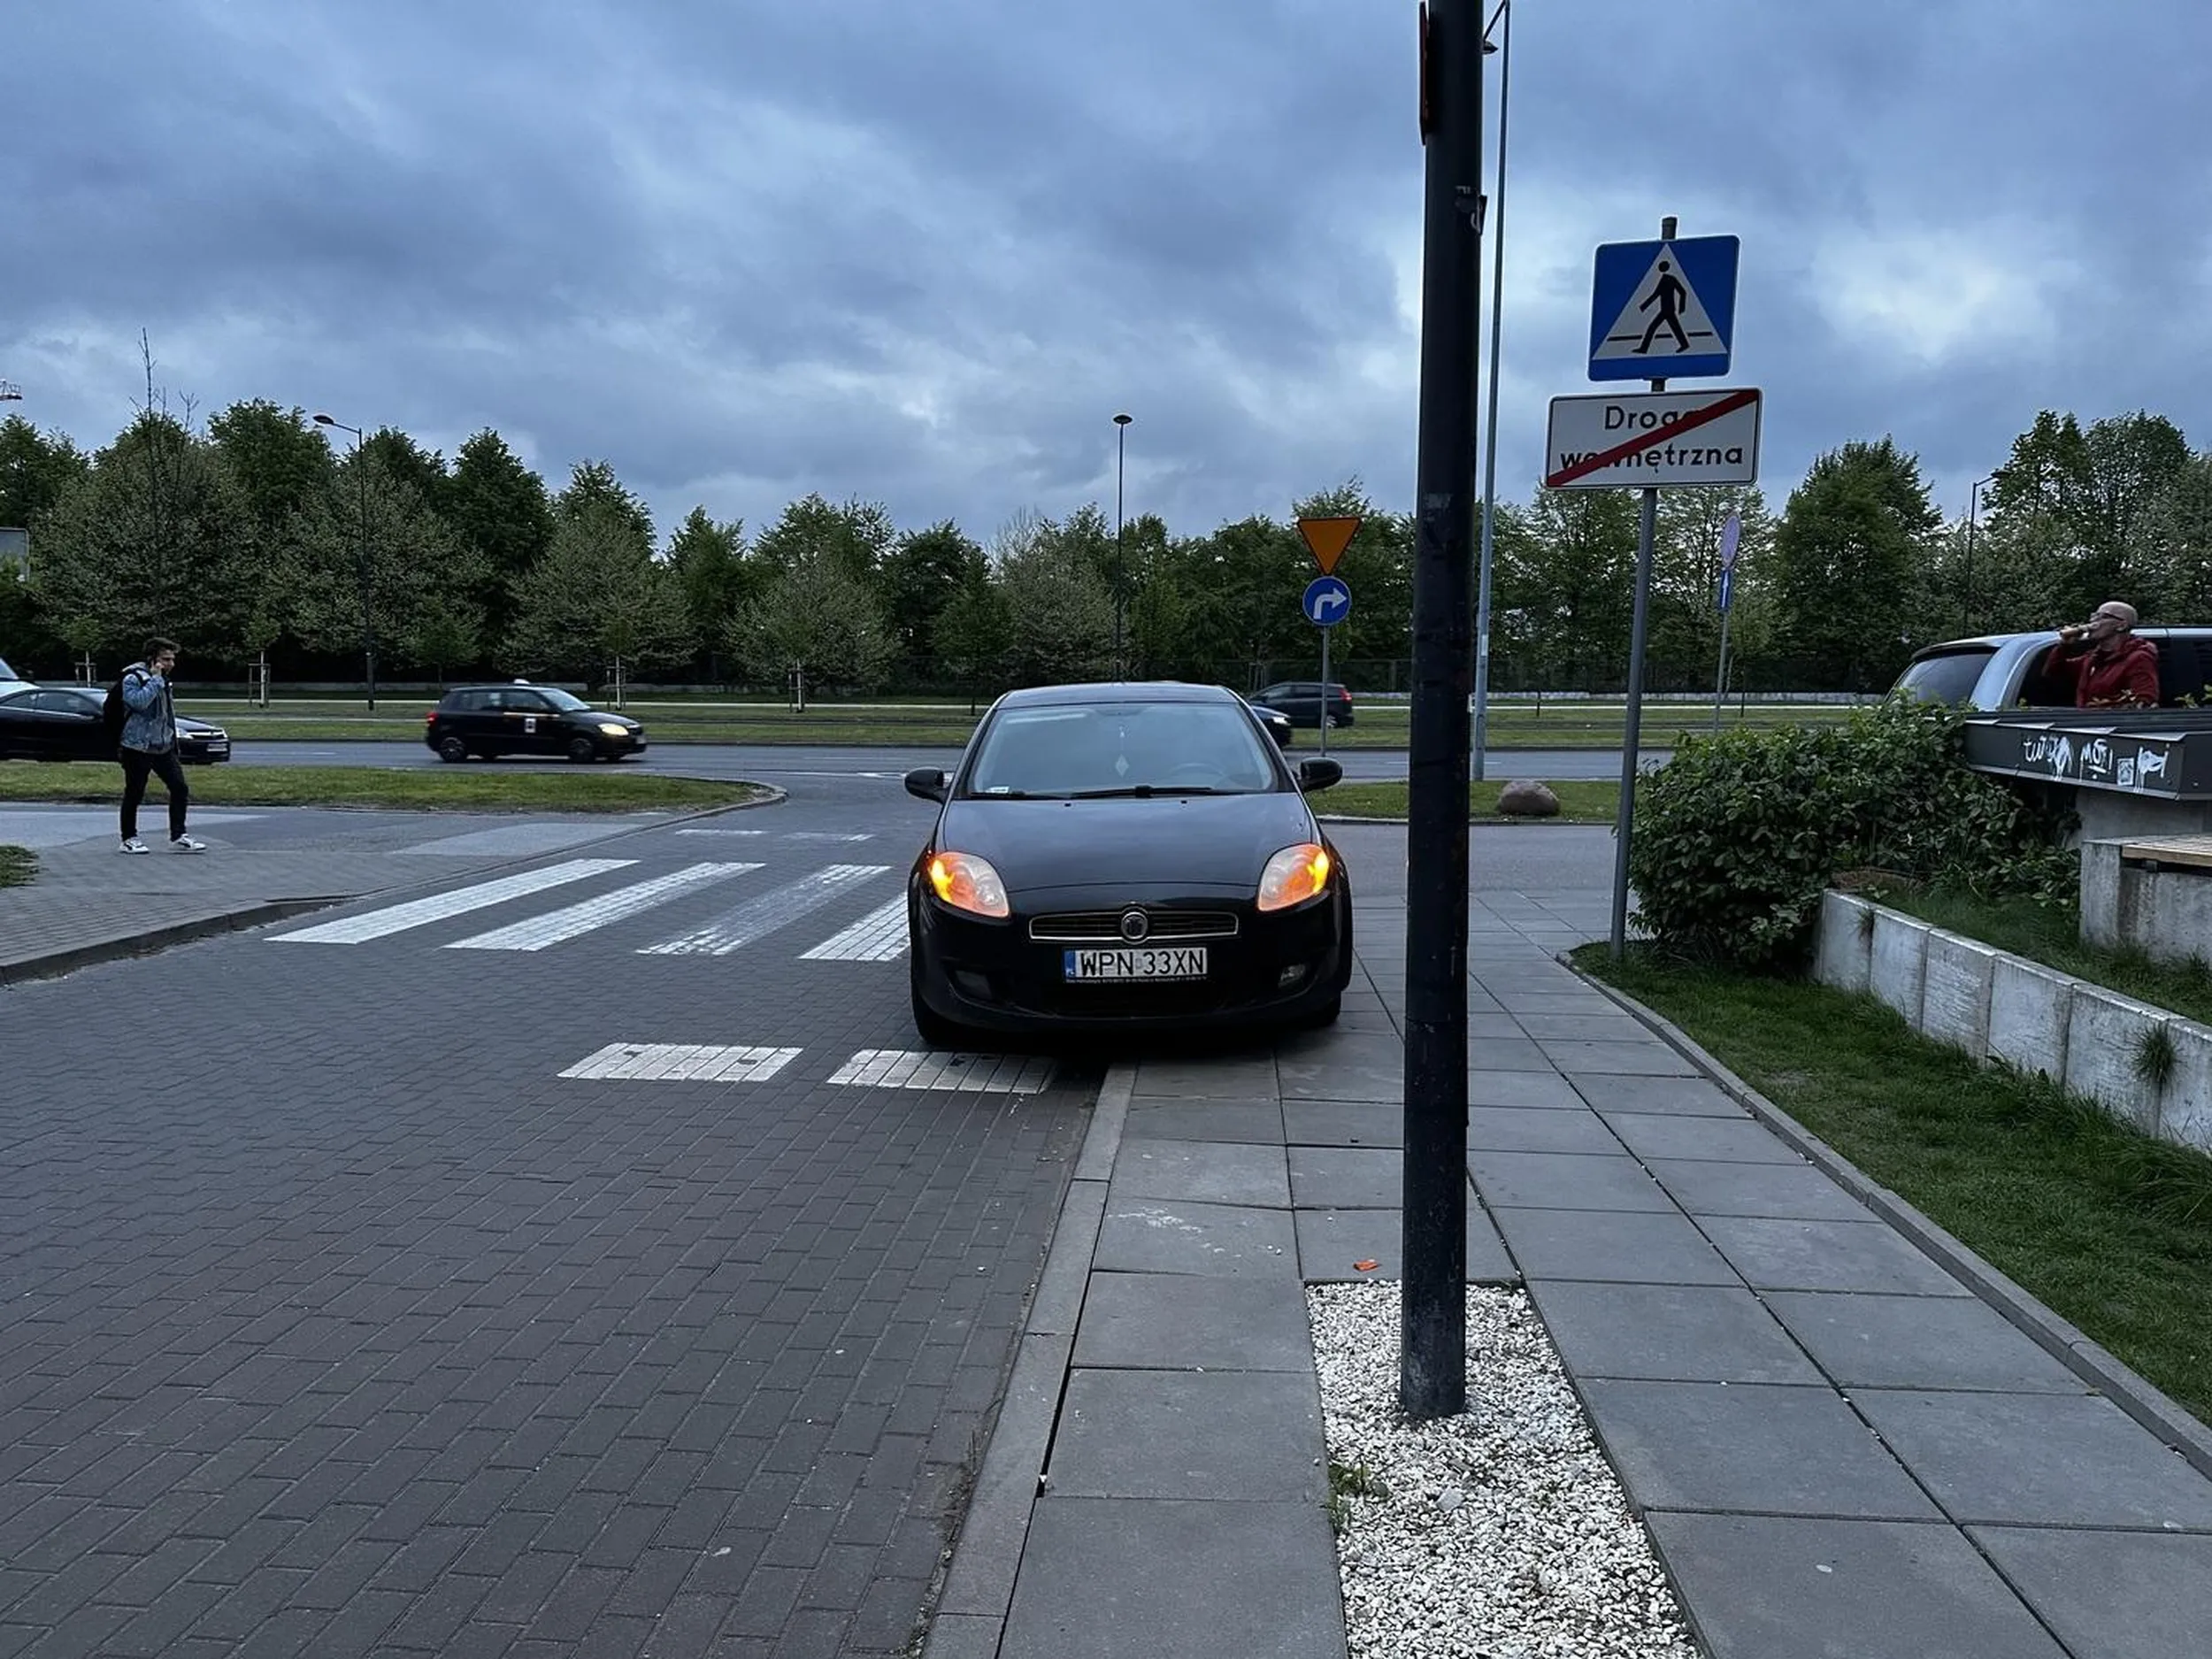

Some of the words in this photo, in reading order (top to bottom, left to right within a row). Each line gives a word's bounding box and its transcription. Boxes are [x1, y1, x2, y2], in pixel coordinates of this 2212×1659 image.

[1604, 405, 1701, 431] Drog
[1079, 951, 1134, 977] WPN
[1142, 949, 1204, 975] 33XN
